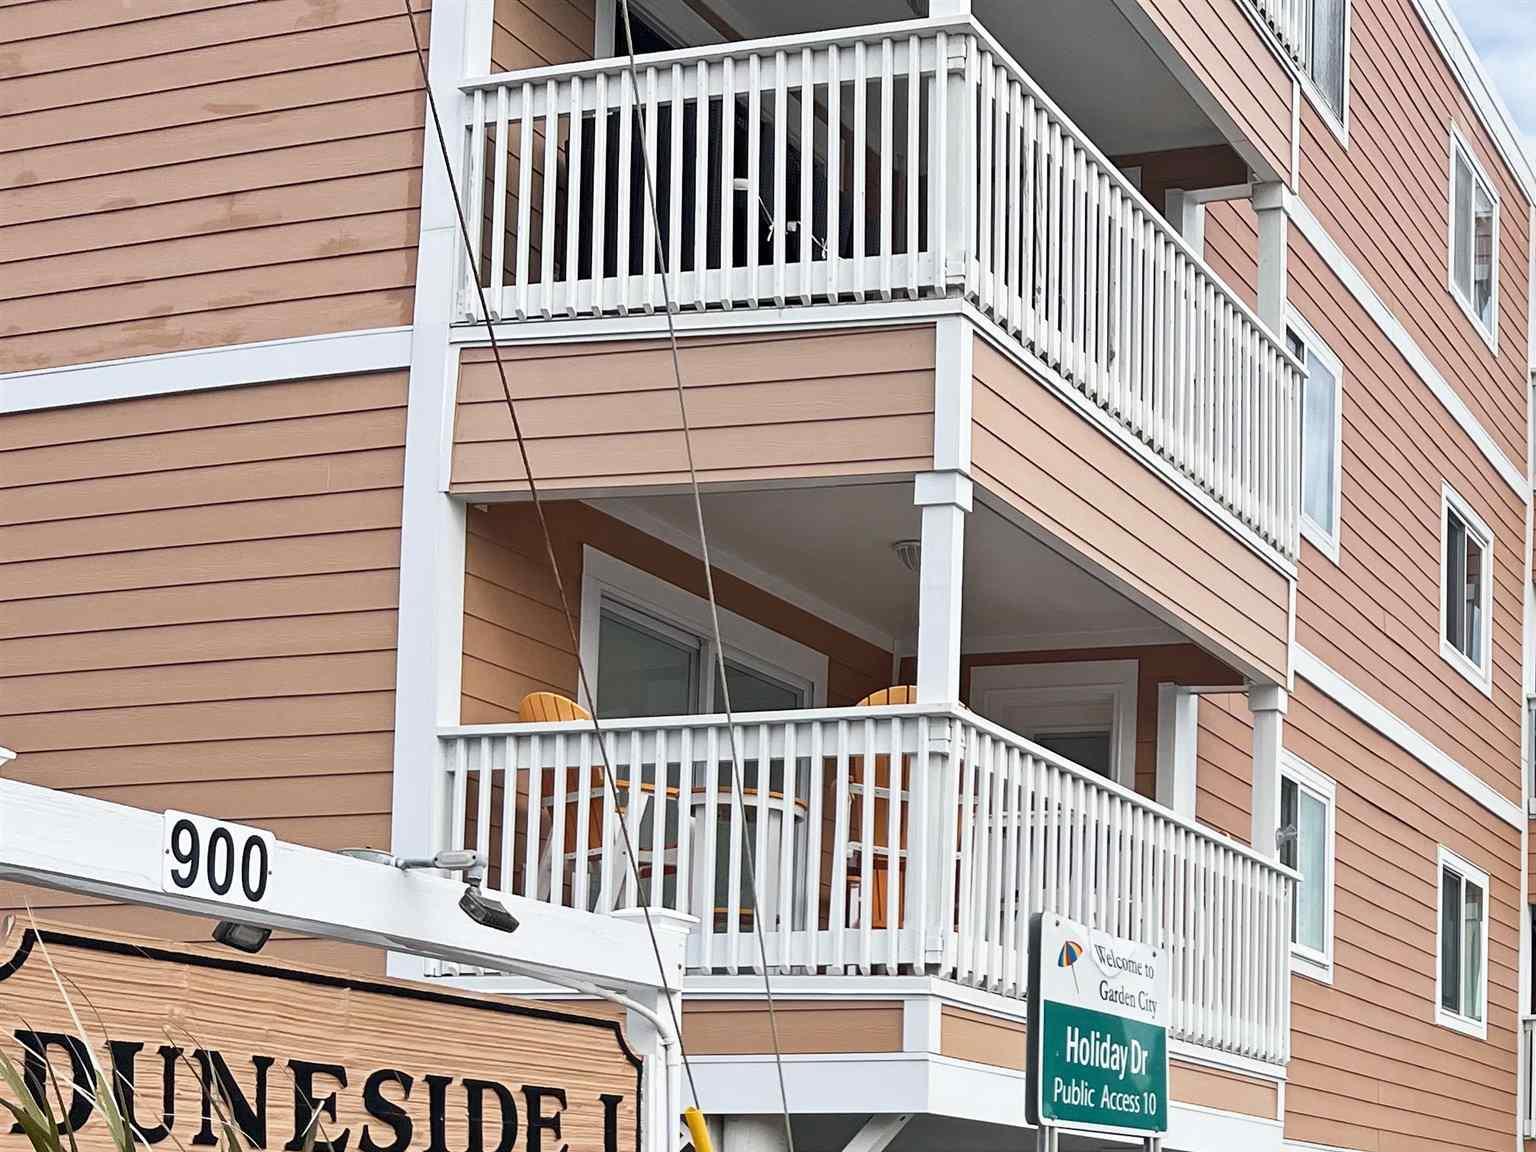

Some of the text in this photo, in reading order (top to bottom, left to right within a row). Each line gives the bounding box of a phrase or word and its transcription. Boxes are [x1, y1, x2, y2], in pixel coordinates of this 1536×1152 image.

[169, 819, 269, 902] 900
[1095, 945, 1154, 979] Welcome to
[1100, 980, 1157, 1018] Garden City
[1066, 1025, 1148, 1080] Holiday Dr
[1054, 1077, 1157, 1116] Public Access 10
